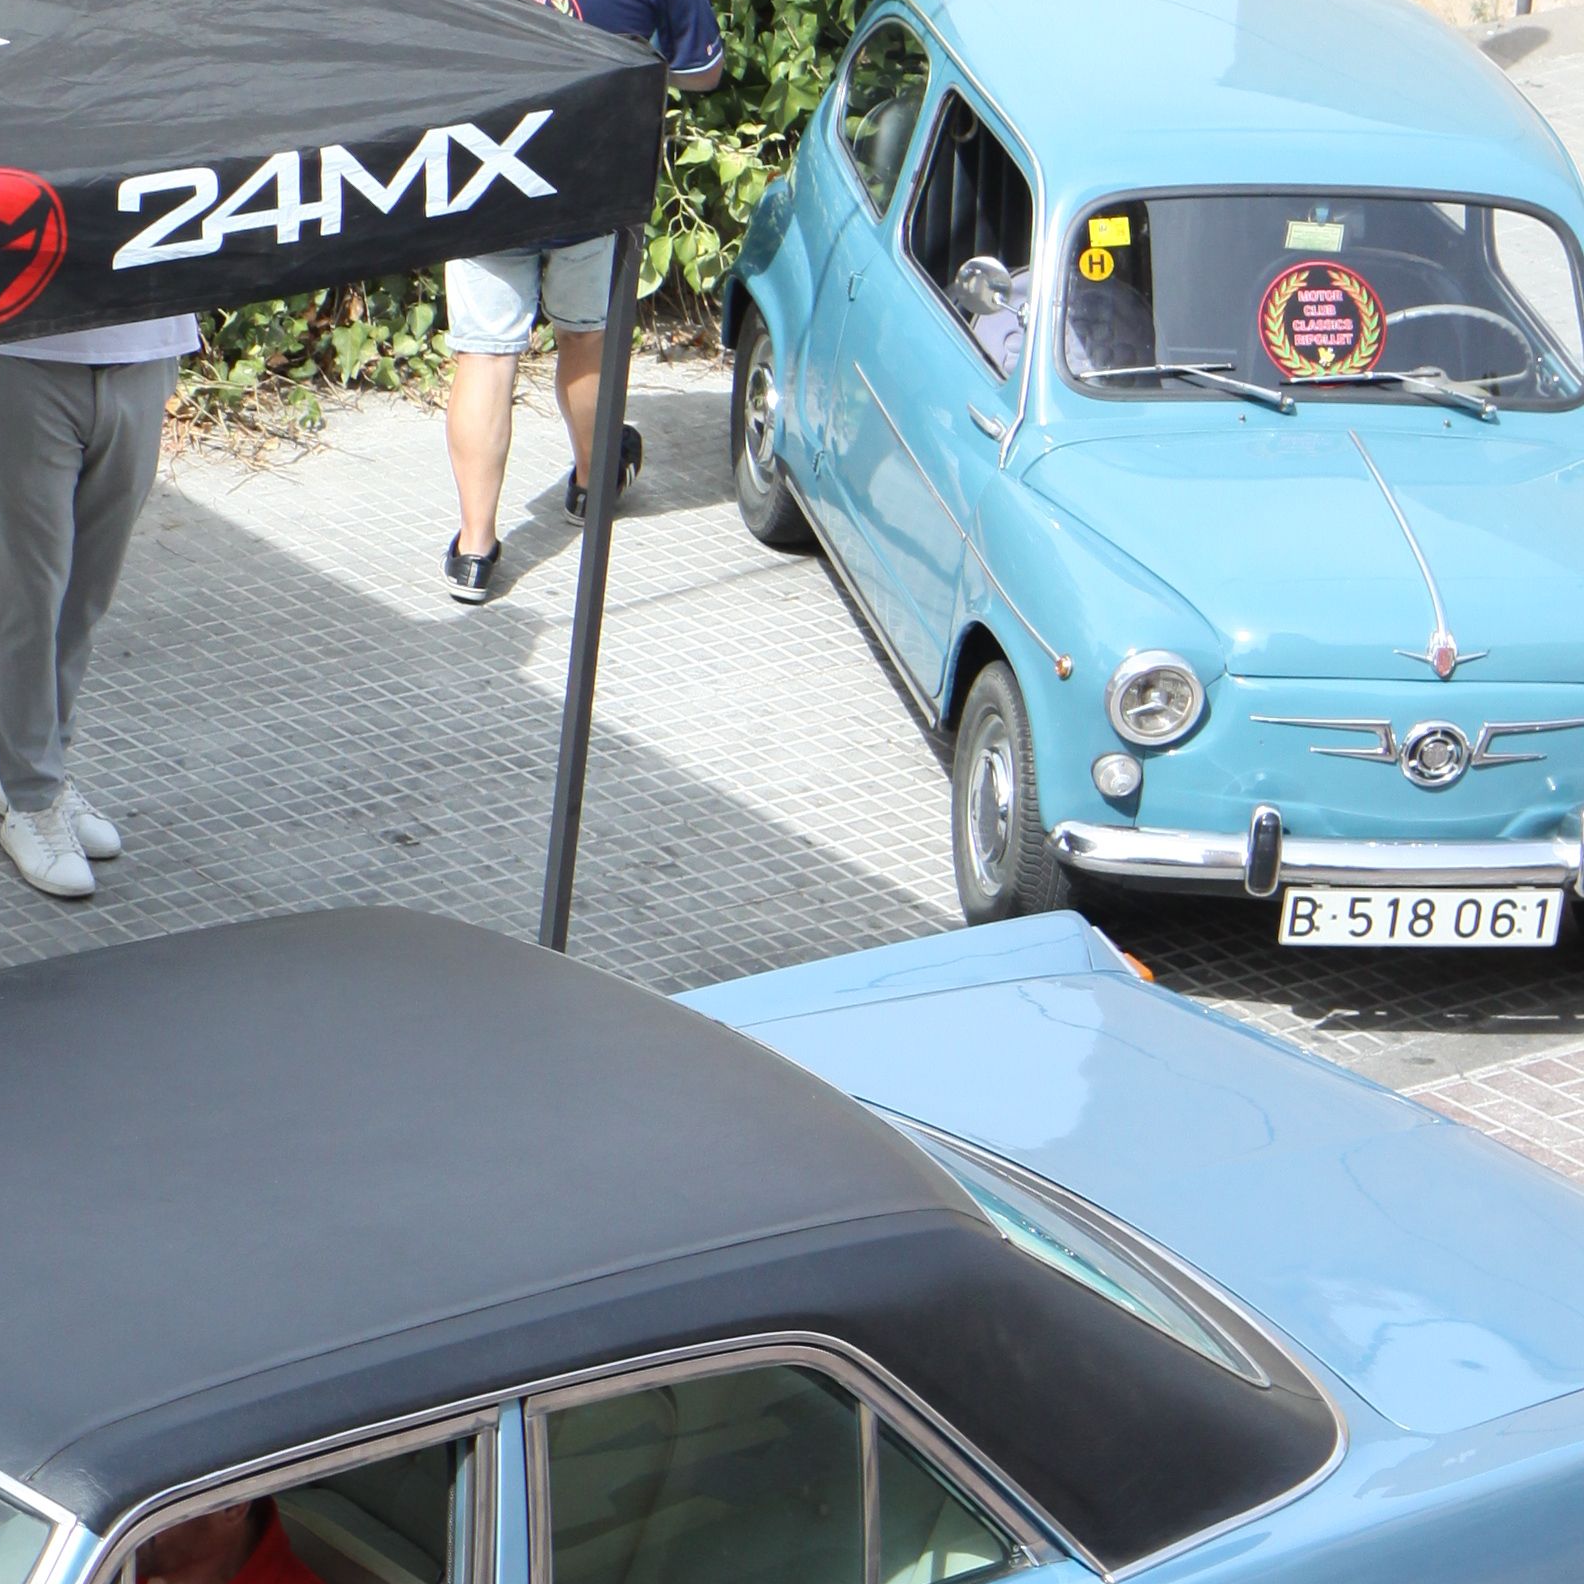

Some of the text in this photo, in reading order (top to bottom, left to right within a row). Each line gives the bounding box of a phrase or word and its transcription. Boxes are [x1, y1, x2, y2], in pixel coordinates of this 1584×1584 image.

[111, 109, 557, 270] 24MX
[1088, 253, 1105, 274] H
[1297, 289, 1344, 303] MOTOR
[1303, 304, 1337, 317] CLUB
[1292, 318, 1354, 332] CLASSICS
[1293, 332, 1354, 346] RIPOLLET
